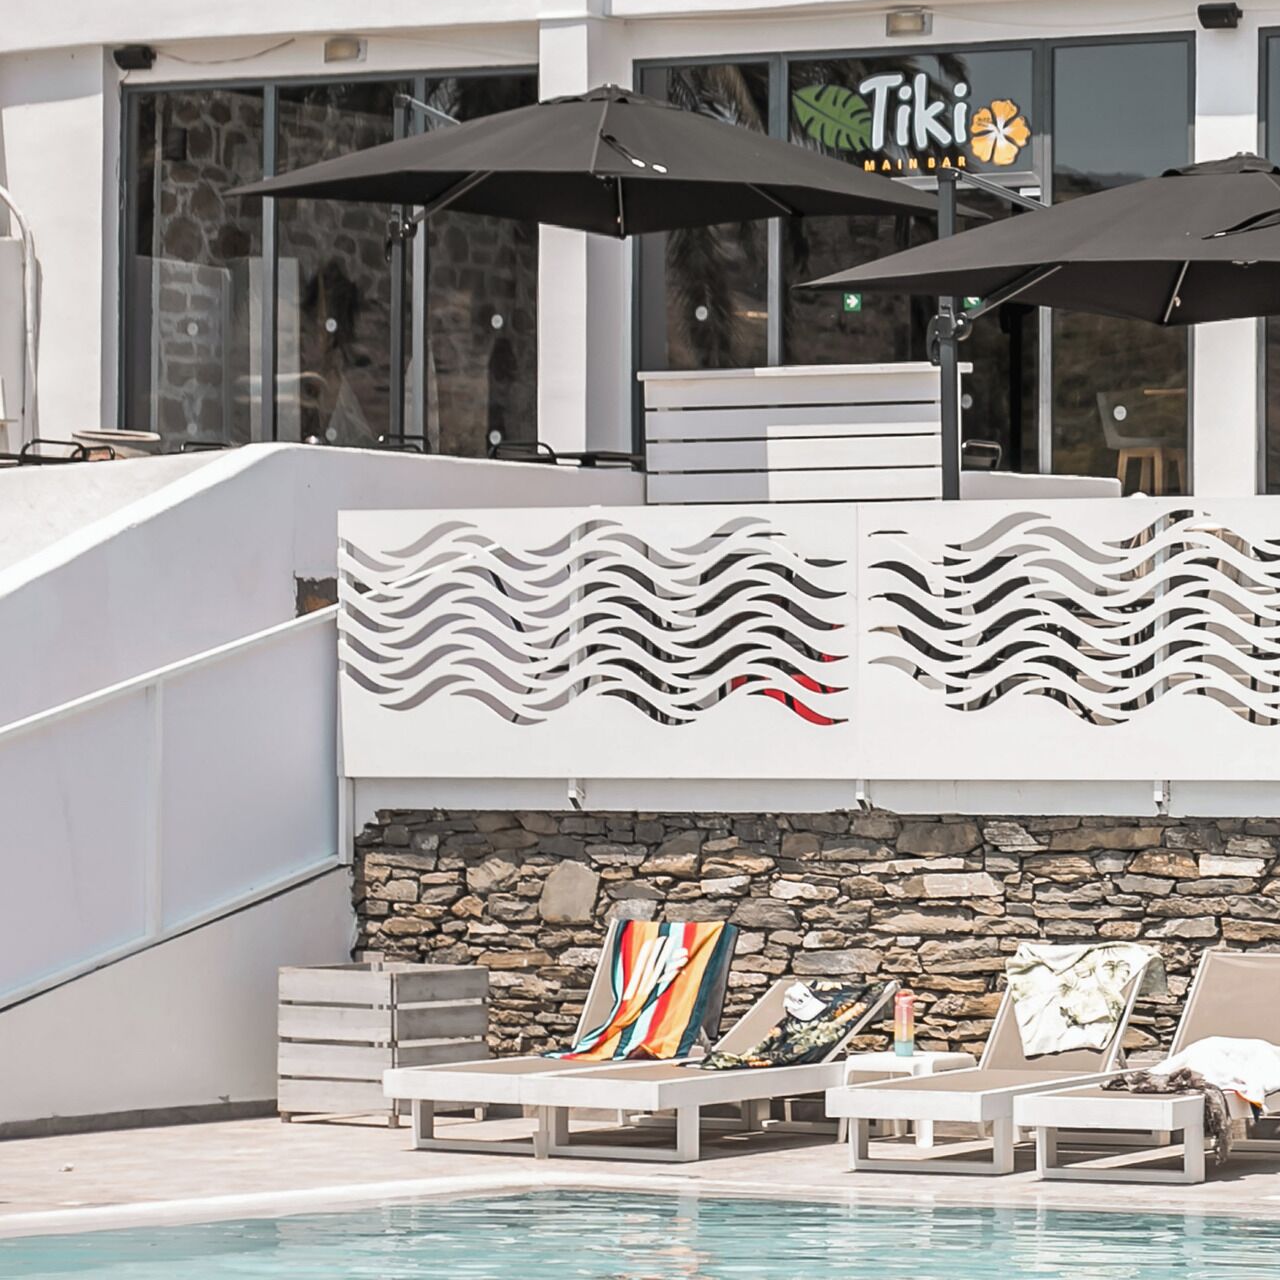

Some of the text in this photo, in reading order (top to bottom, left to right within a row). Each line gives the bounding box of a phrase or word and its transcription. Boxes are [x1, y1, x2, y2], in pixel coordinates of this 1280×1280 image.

[858, 72, 968, 151] Tiki
[864, 156, 967, 172] MAIN BAR
